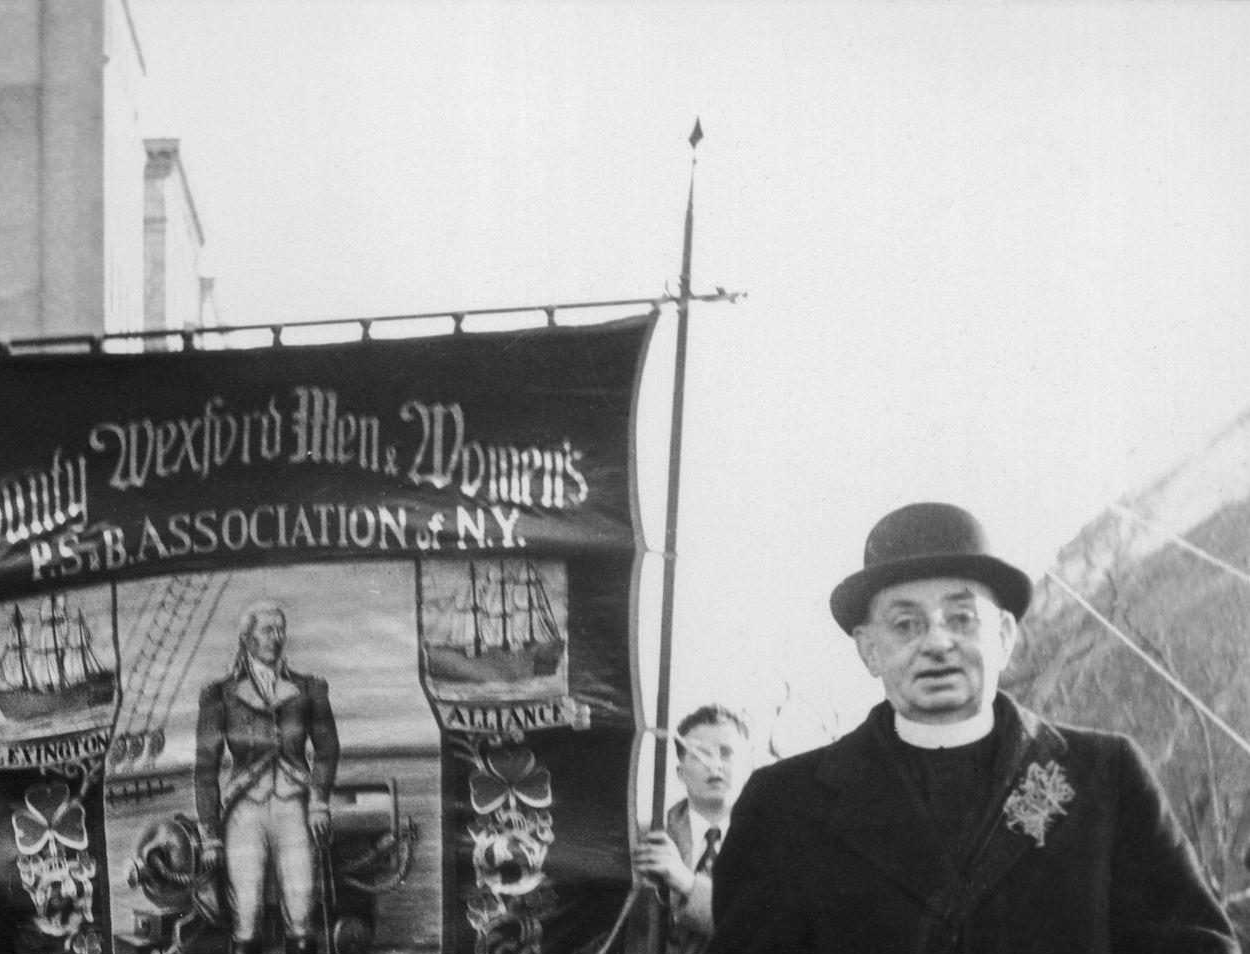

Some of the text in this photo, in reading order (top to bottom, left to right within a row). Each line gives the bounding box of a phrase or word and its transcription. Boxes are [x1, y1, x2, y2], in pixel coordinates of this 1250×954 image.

[89, 396, 282, 490] Wexford
[290, 386, 379, 472] Men
[136, 503, 406, 563] ASSOCIATION
[416, 511, 445, 550] of
